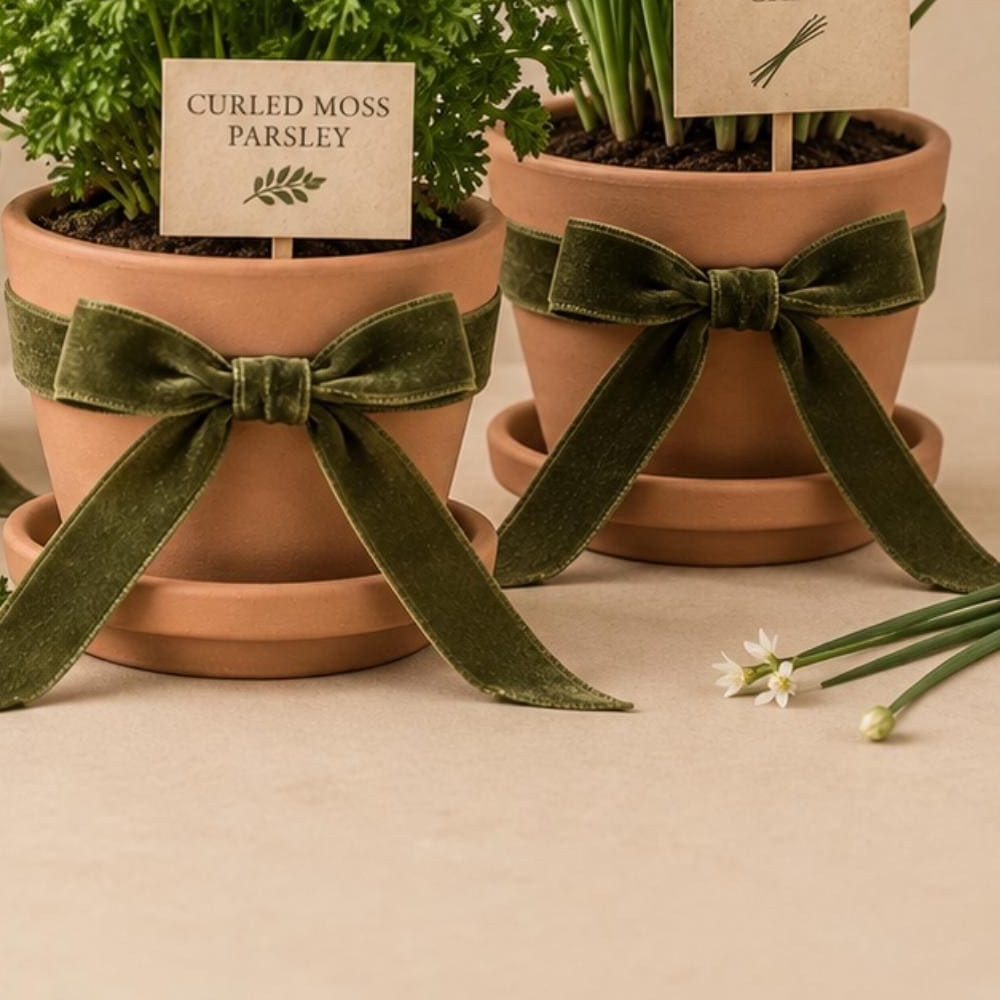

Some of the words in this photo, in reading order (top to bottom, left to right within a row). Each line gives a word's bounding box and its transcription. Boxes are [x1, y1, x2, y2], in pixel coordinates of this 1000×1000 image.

[187, 93, 302, 117] CURLED
[313, 95, 390, 118] MOSS
[228, 124, 351, 149] PARSLEY
